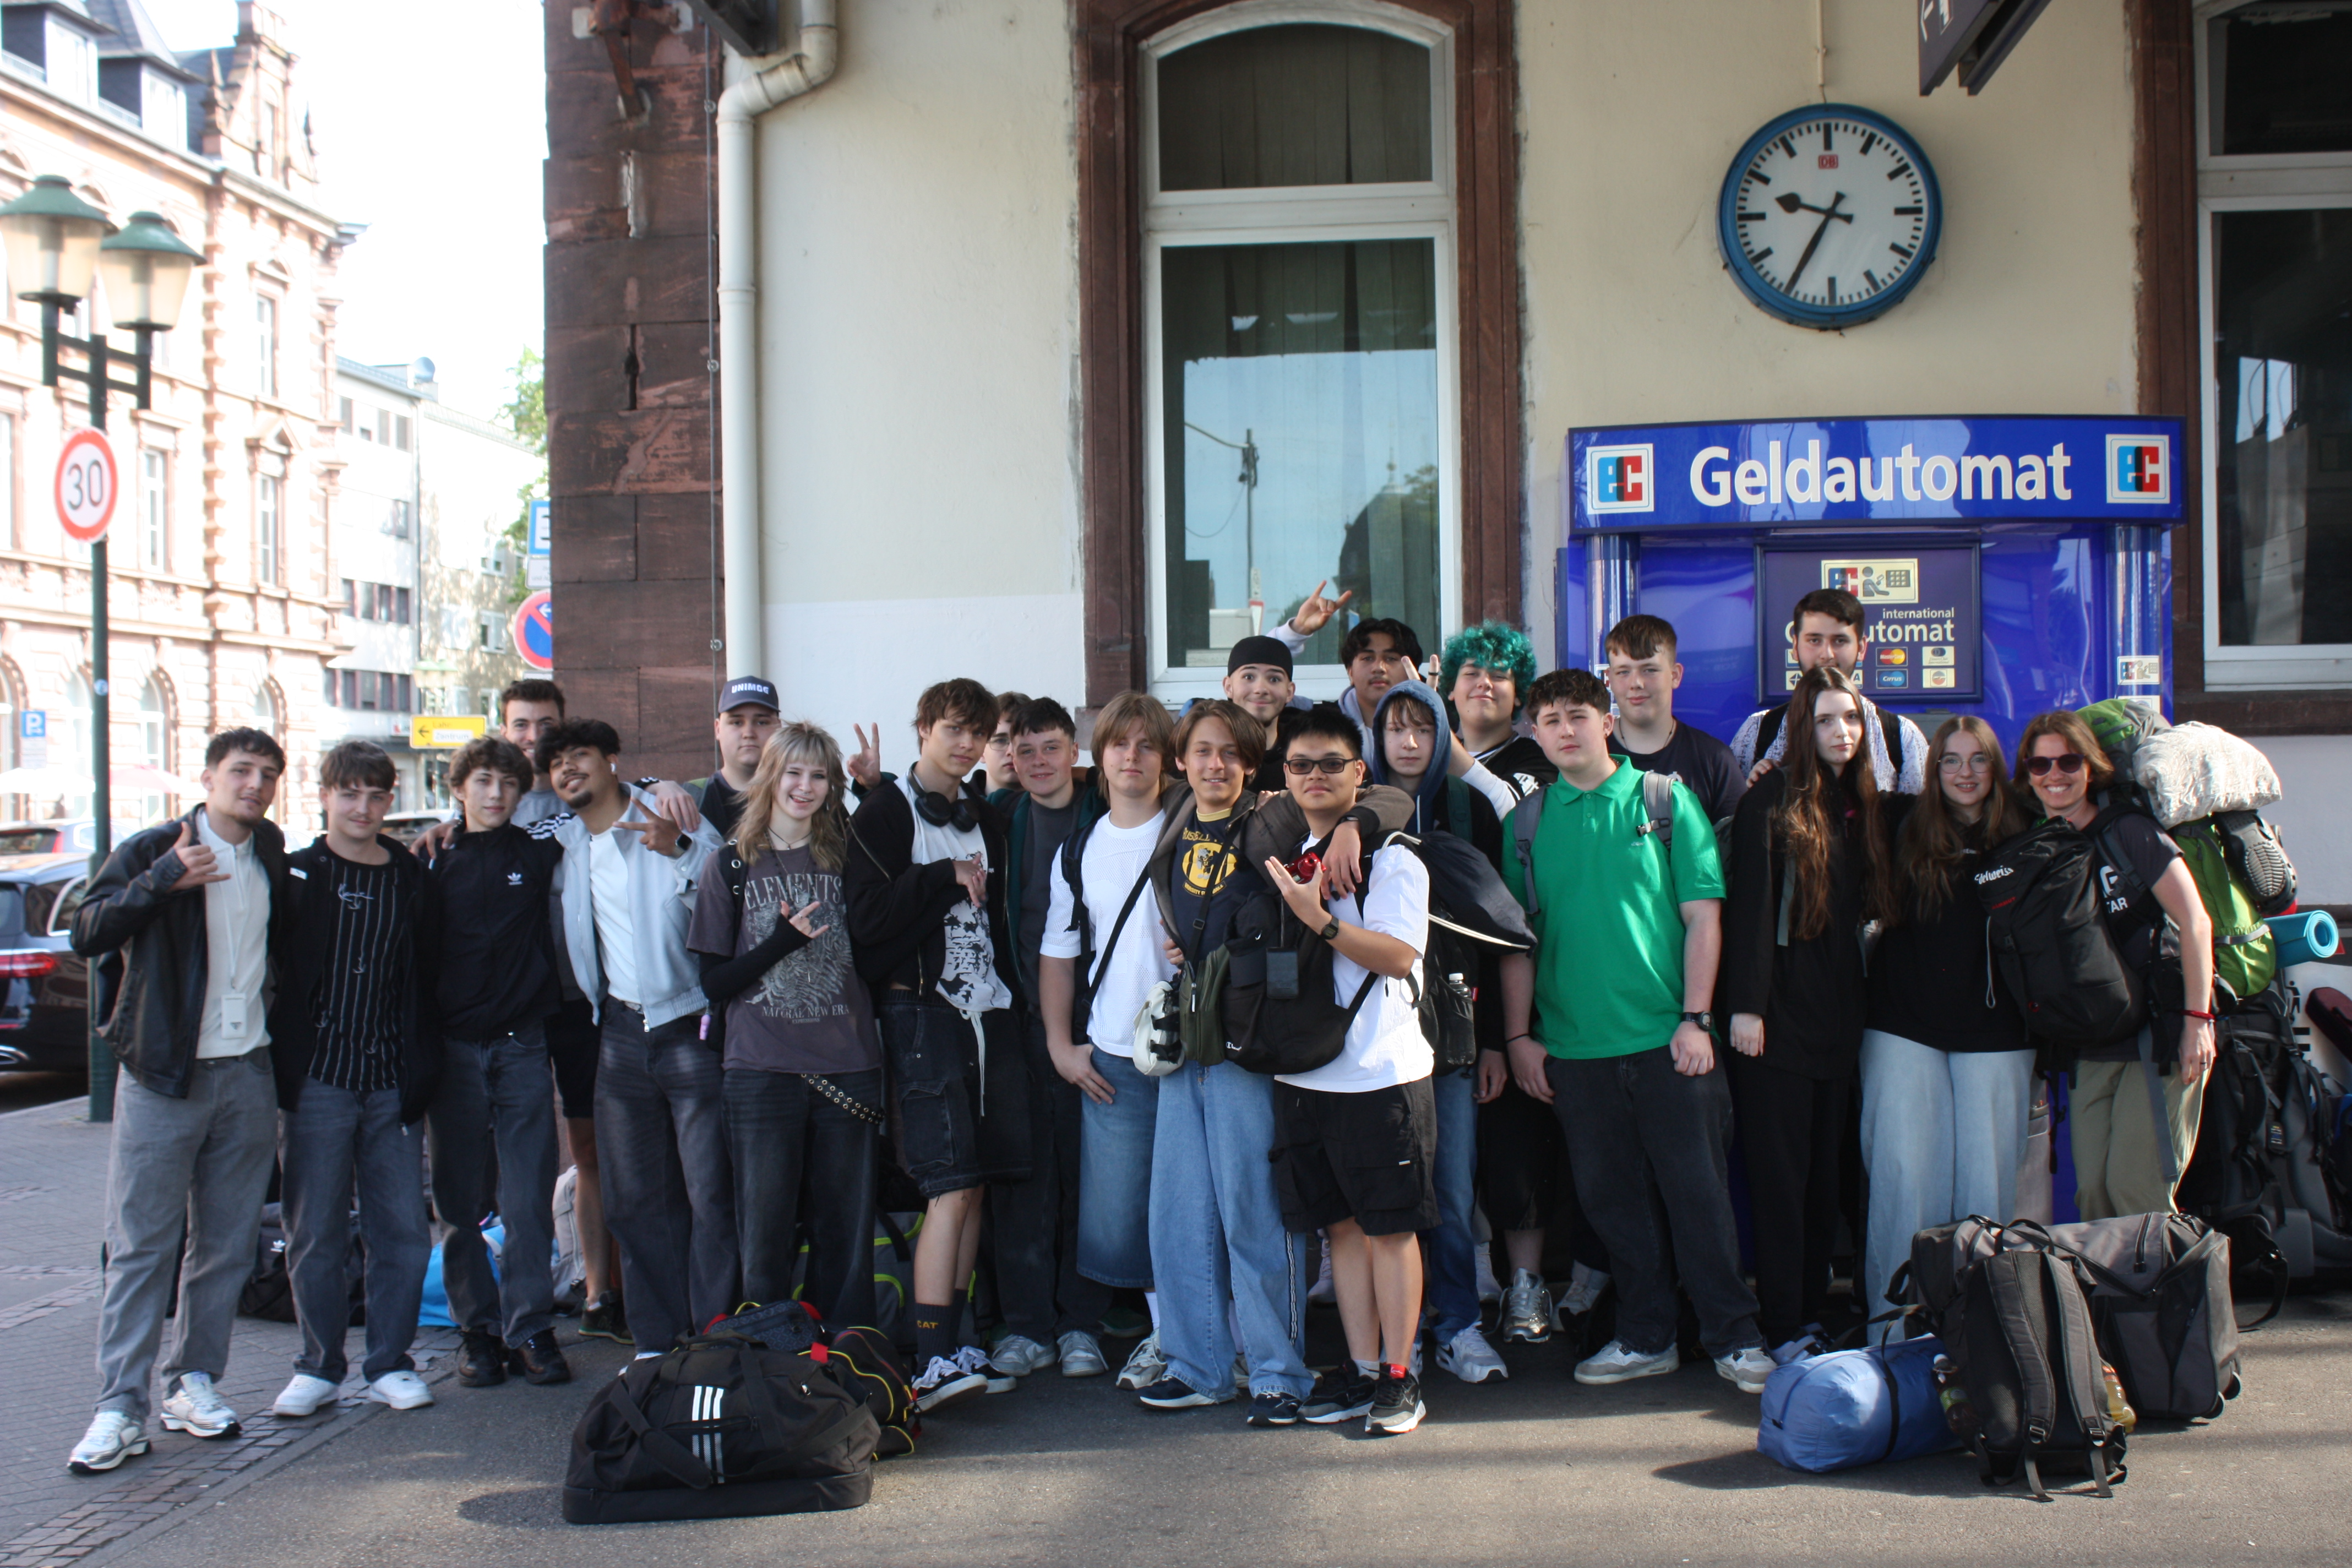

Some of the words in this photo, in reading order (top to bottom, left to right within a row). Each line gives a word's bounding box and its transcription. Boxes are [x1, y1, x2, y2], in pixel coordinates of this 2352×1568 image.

[1819, 155, 1838, 169] DB
[1690, 439, 2072, 507] Geldautomat
[67, 459, 103, 510] 30
[1882, 607, 1954, 619] international
[731, 683, 769, 694] UNIMOG
[744, 874, 842, 910] ELEMENTS
[762, 1005, 804, 1019] NATURAL
[808, 1006, 830, 1018] NEW
[832, 1004, 850, 1016] ERA
[917, 1320, 938, 1329] CAT
